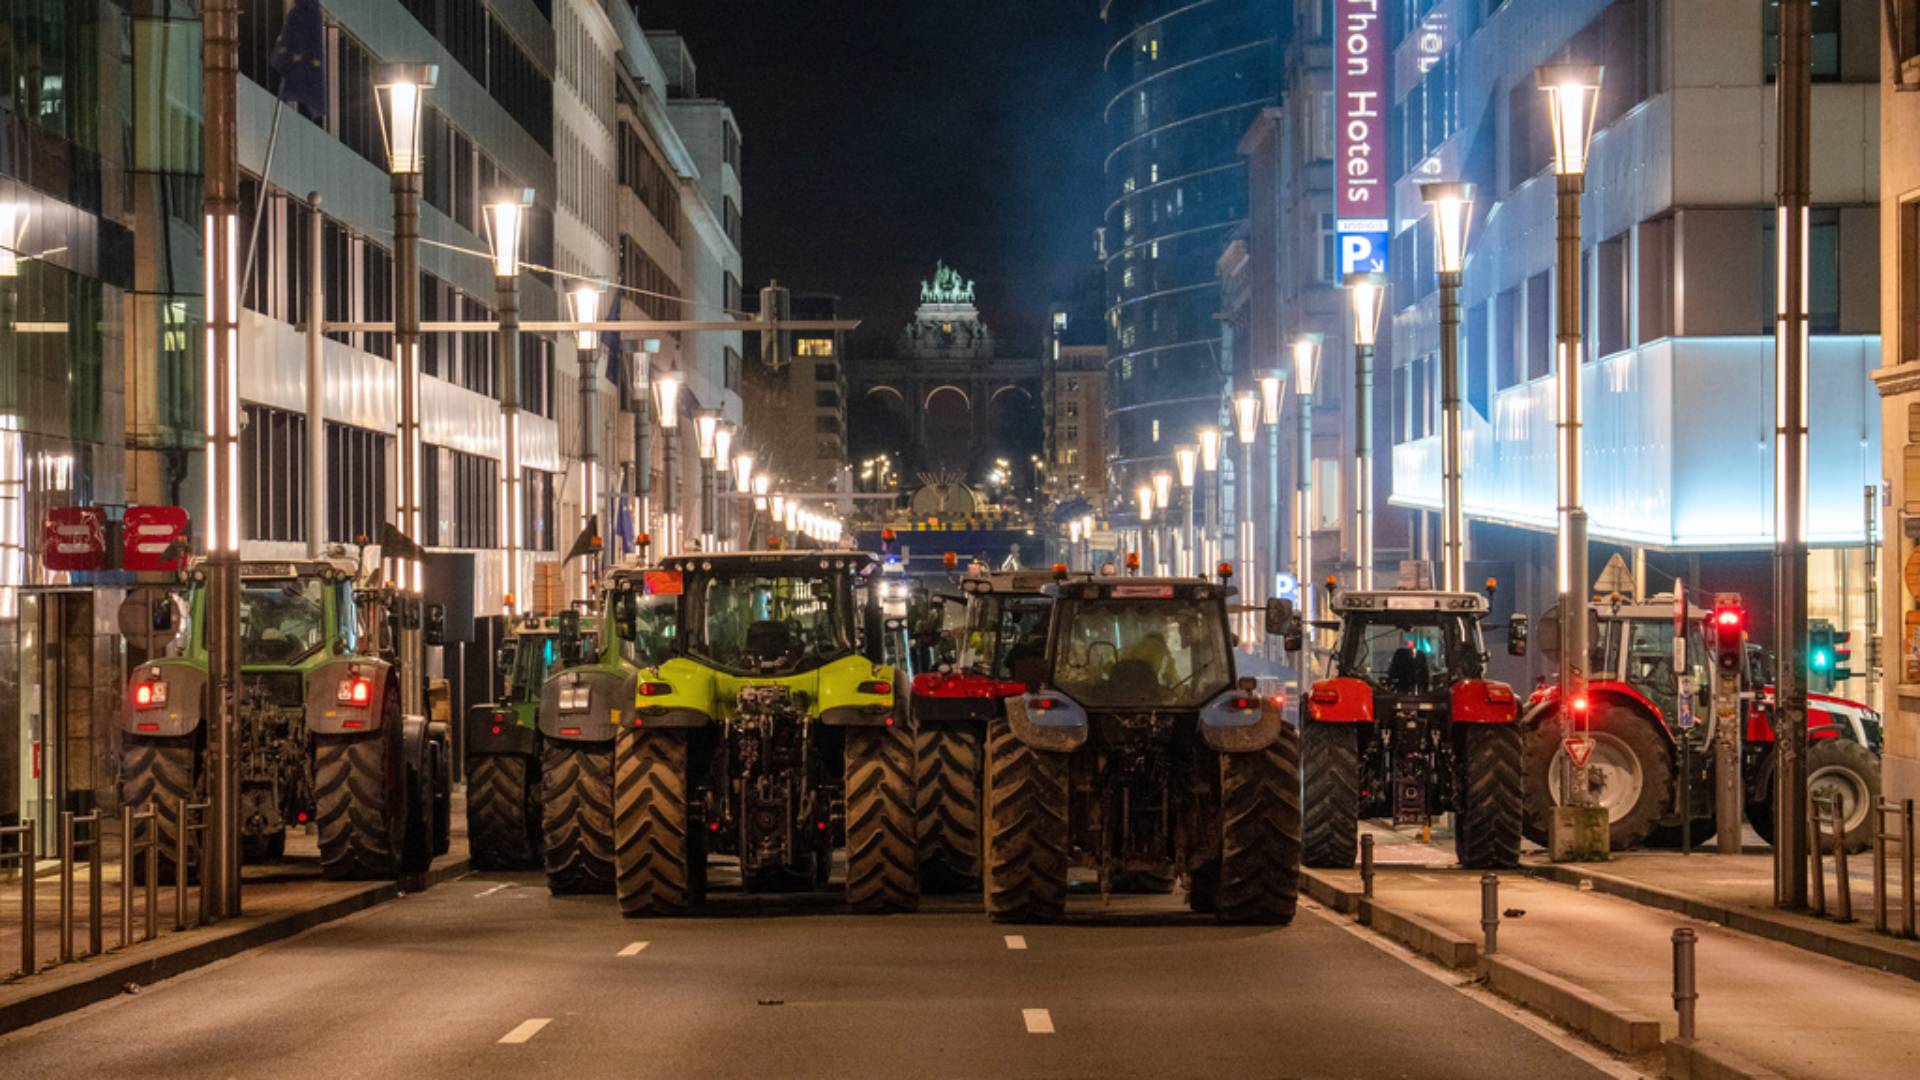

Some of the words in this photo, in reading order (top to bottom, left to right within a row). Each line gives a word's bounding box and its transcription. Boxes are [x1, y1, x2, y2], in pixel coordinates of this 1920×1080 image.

[1347, 91, 1378, 202] Hotels
[1342, 235, 1372, 273] P
[1276, 574, 1293, 599] P
